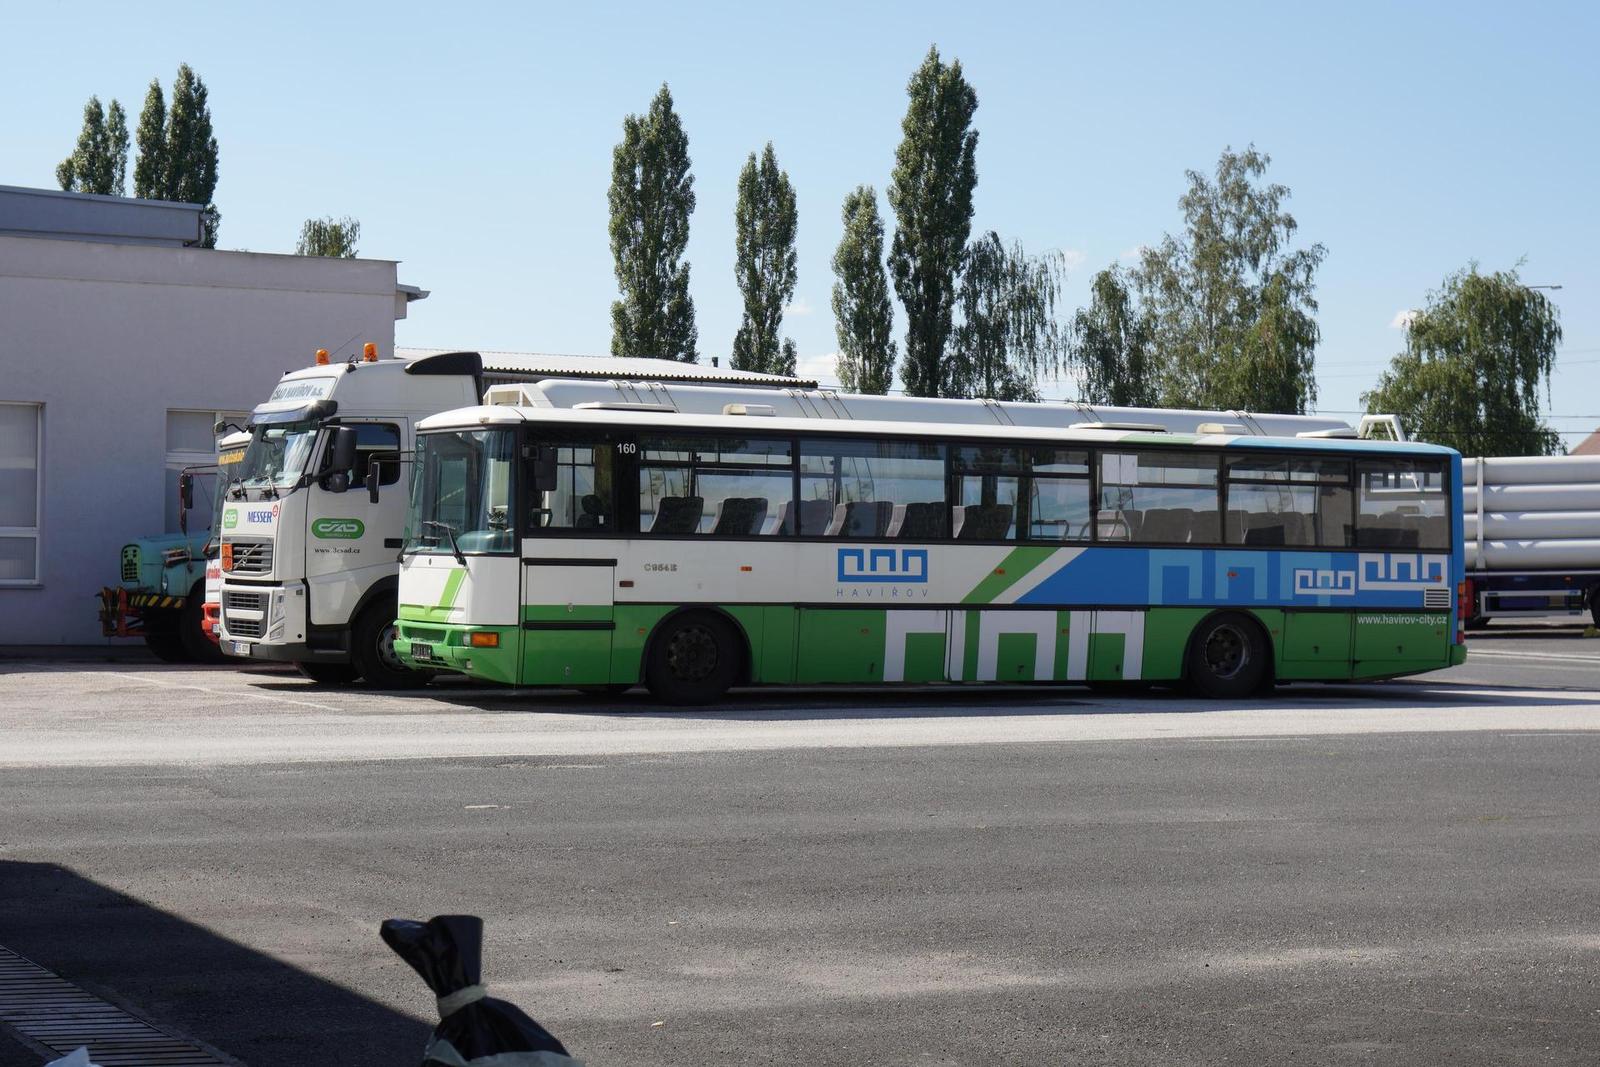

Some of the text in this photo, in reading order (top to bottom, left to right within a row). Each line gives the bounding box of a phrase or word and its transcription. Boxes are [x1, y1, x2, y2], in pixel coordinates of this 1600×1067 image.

[617, 443, 636, 454] 160
[247, 511, 272, 523] MESSER
[1357, 614, 1448, 626] www.havirov-city.cz
